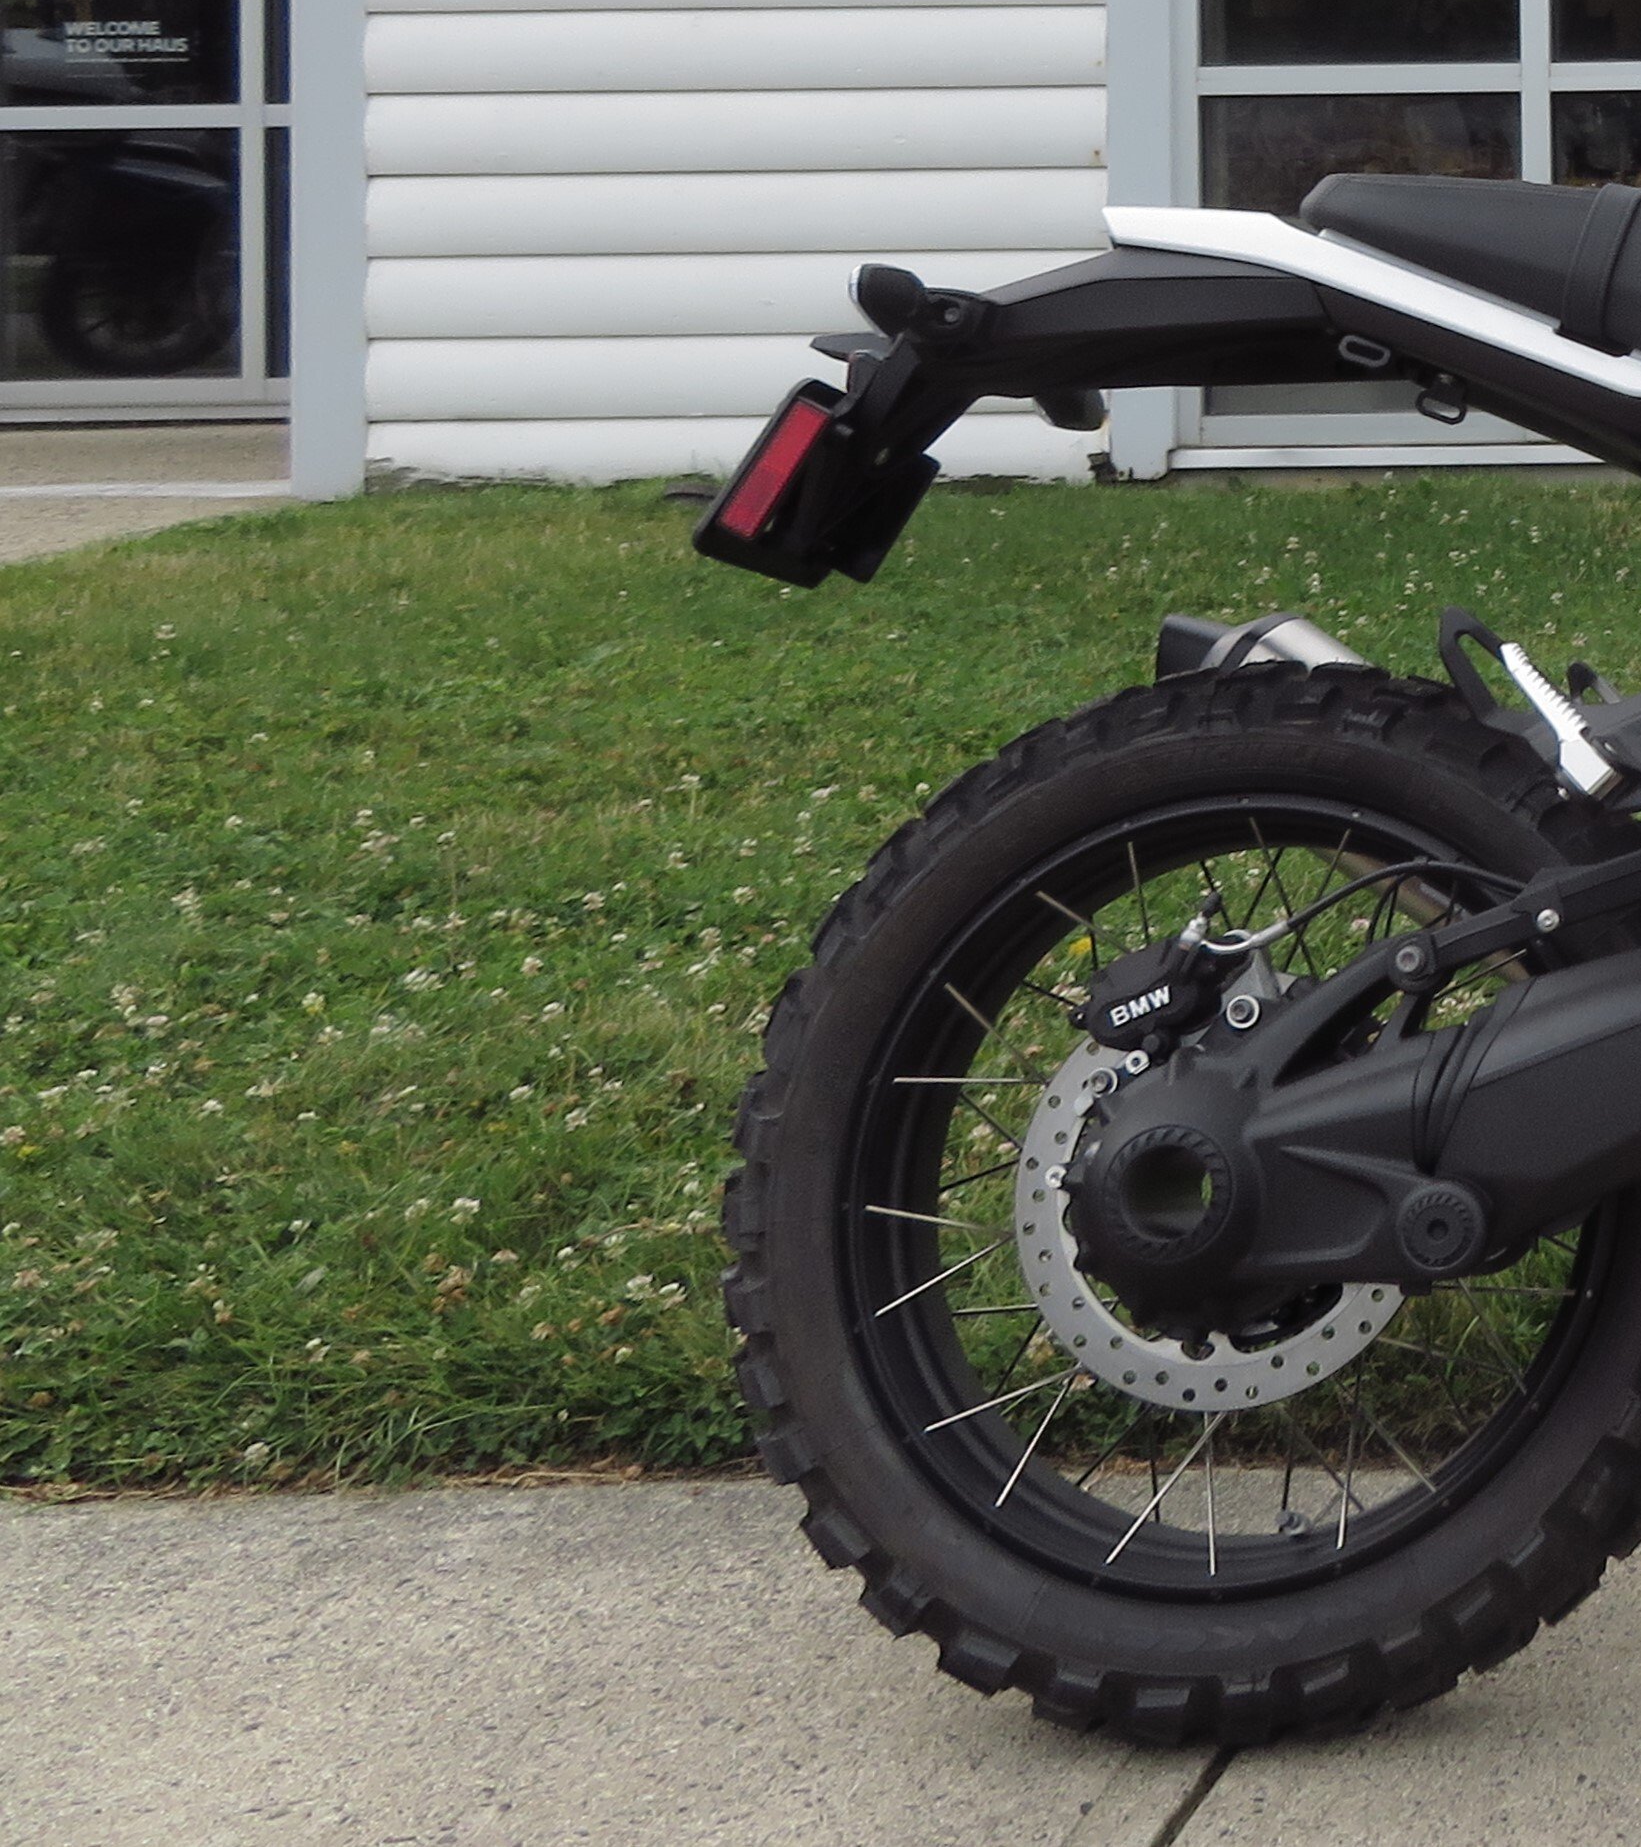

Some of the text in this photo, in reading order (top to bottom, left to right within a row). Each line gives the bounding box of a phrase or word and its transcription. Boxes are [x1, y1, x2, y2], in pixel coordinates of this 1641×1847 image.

[64, 20, 161, 36] WELCOME
[65, 37, 190, 53] TO OUR HAUS
[1108, 985, 1172, 1027] BMW
